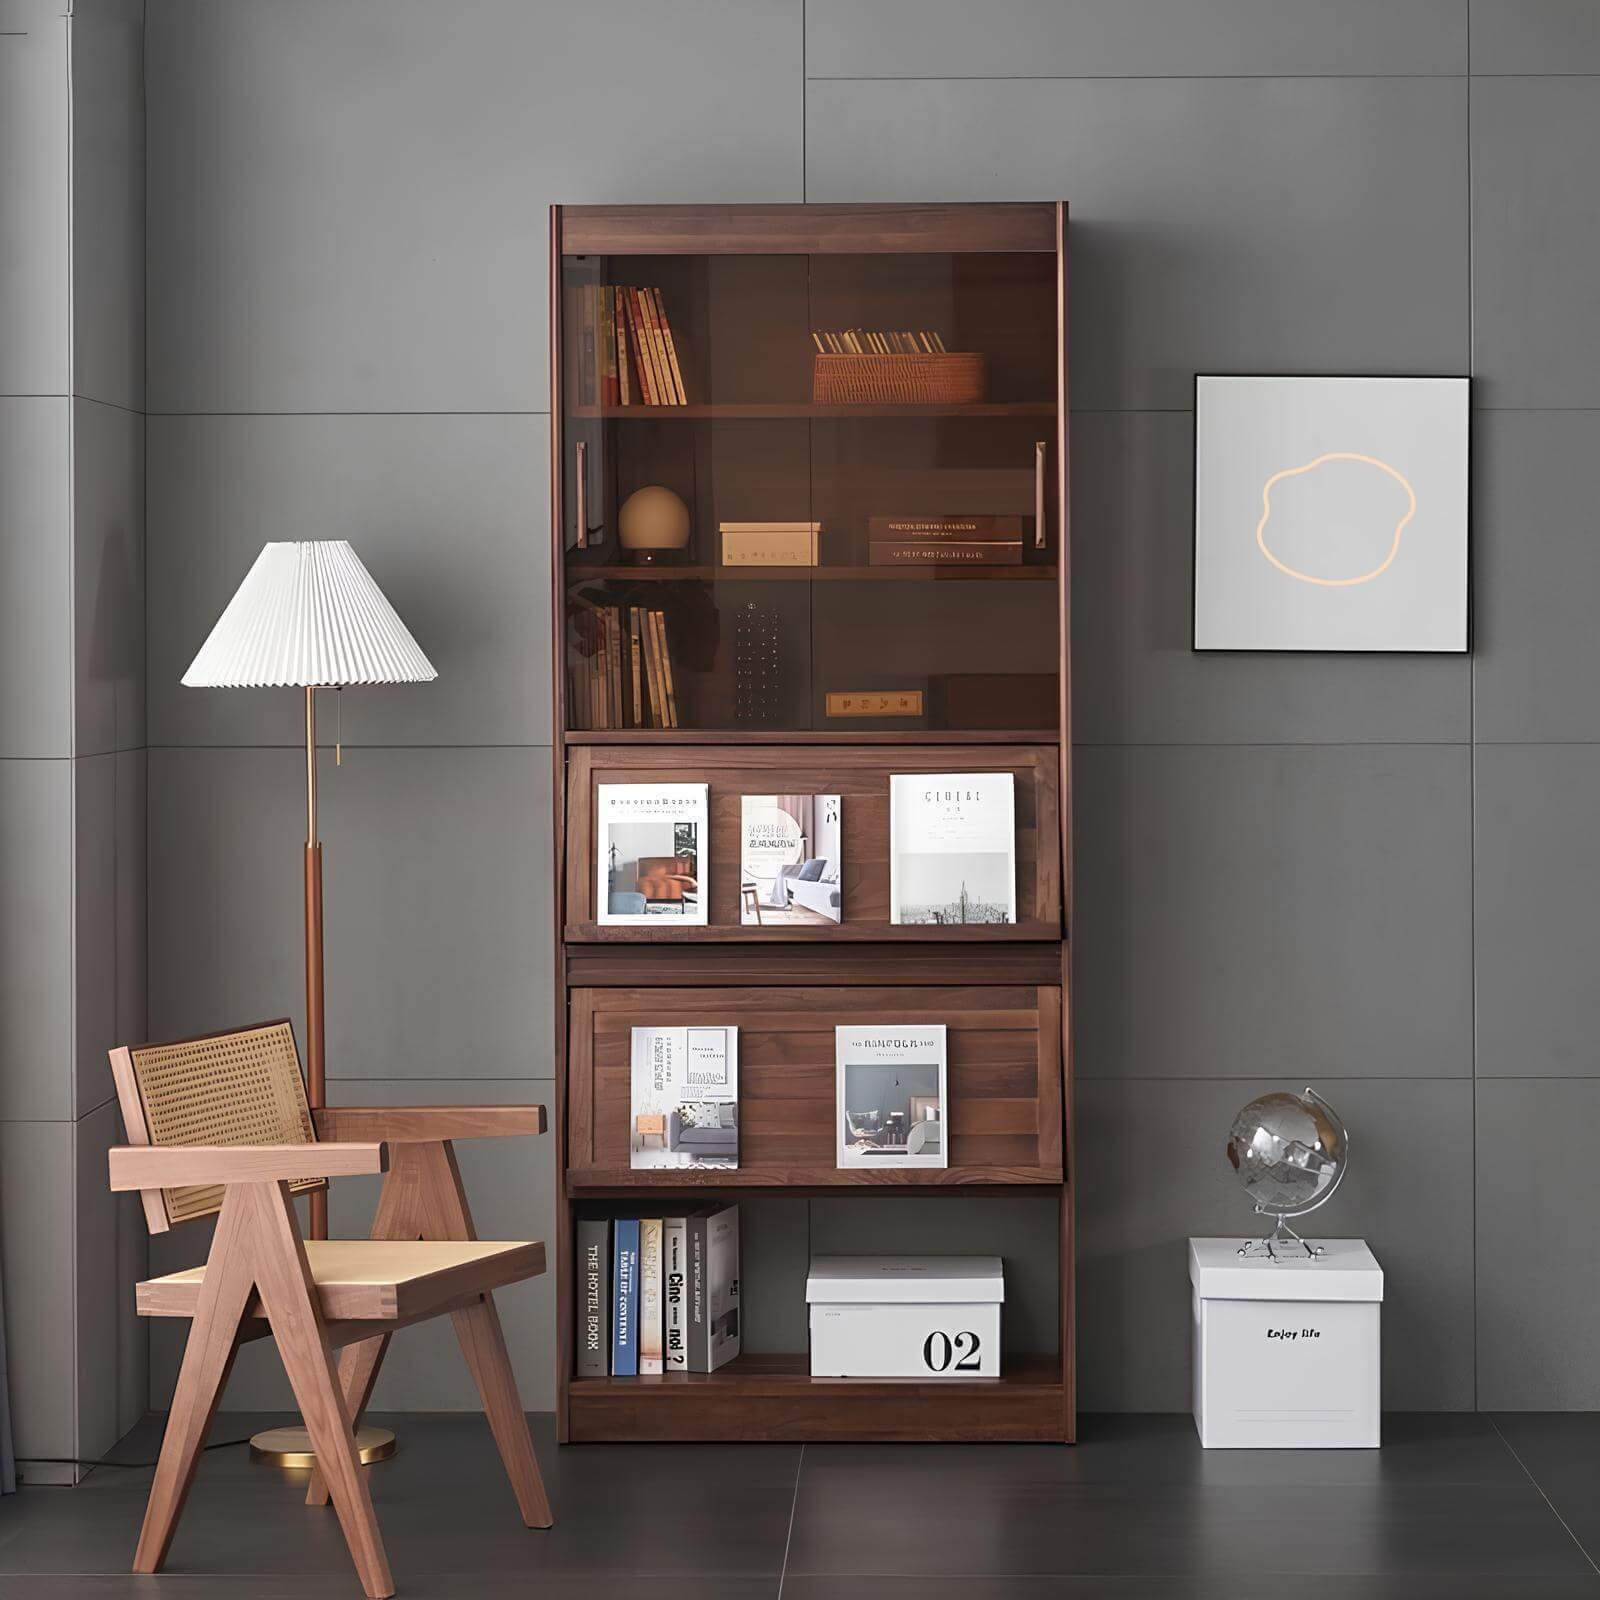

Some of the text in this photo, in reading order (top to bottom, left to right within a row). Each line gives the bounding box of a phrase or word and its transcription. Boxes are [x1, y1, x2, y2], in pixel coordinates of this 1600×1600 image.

[587, 1245, 598, 1271] THE
[587, 1273, 598, 1312] HOTEL
[1267, 1329, 1298, 1340] Enjoy
[923, 1331, 981, 1372] 02
